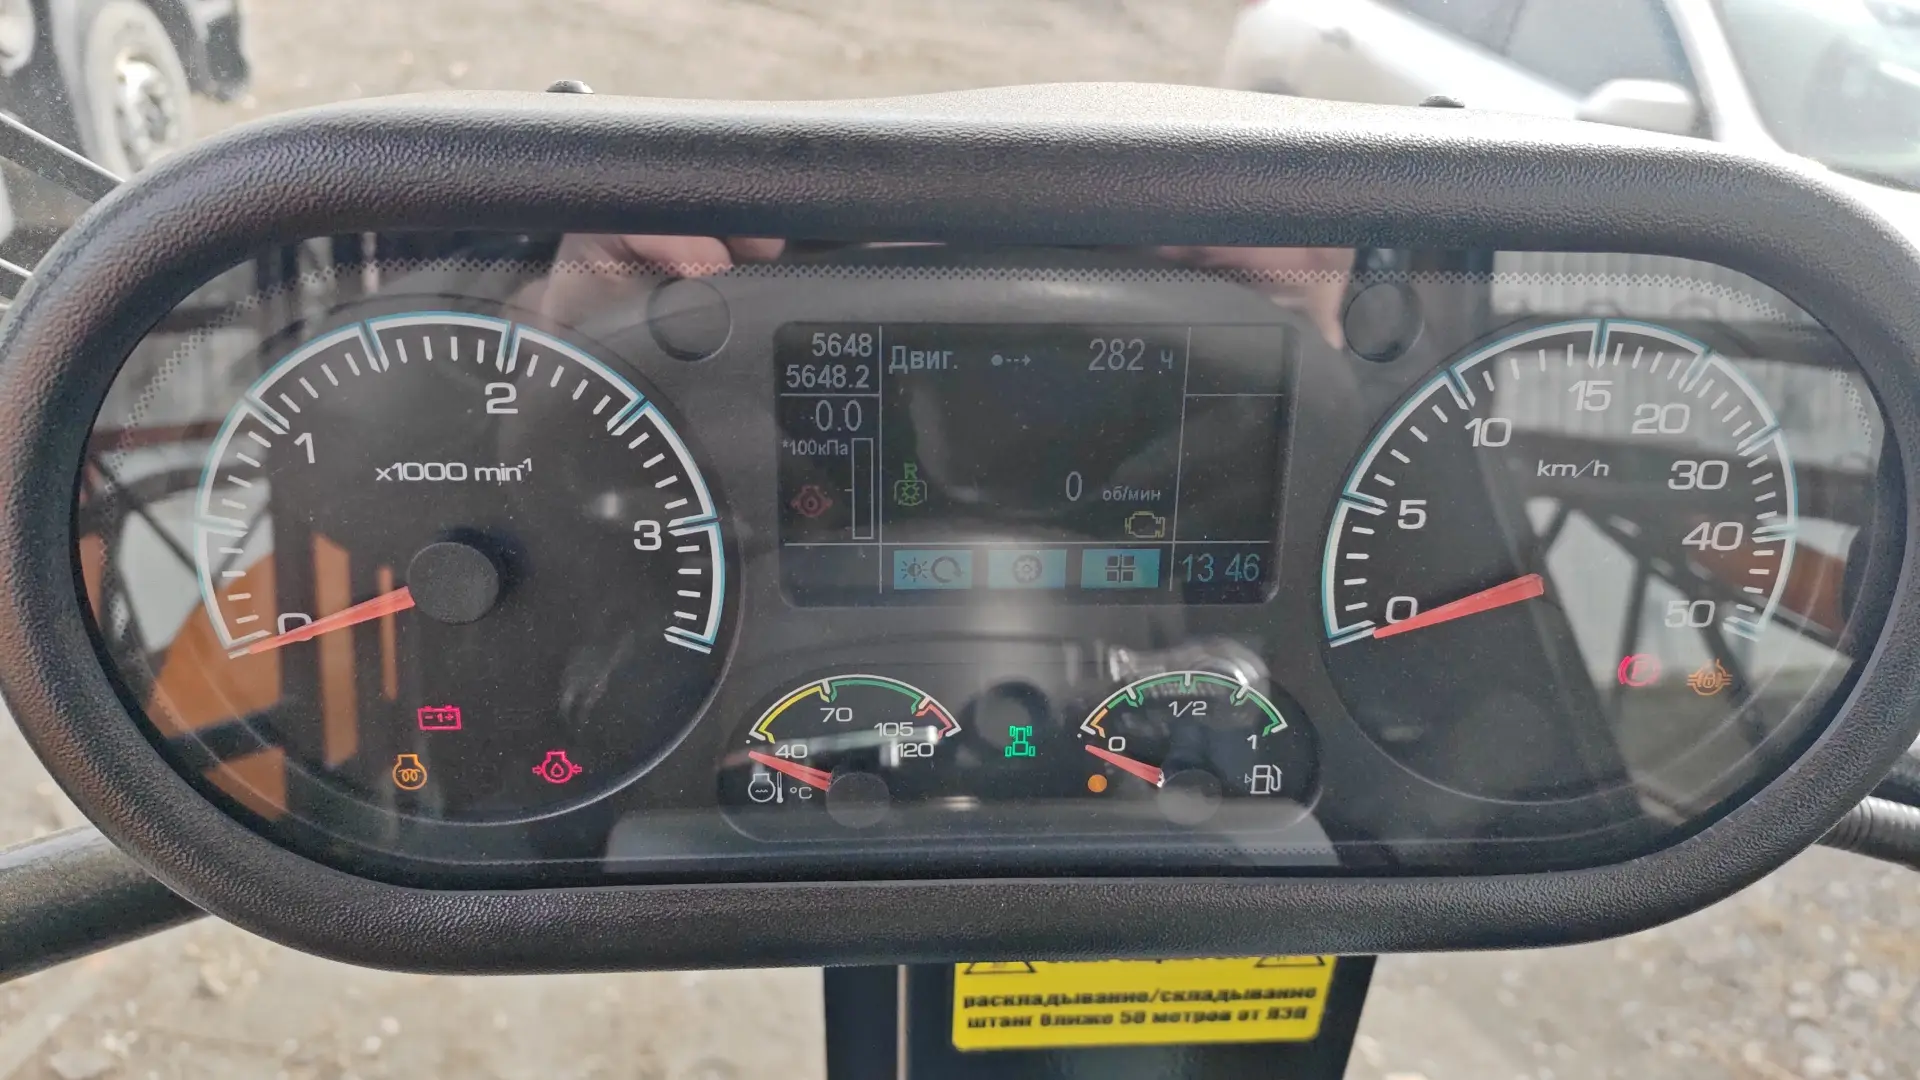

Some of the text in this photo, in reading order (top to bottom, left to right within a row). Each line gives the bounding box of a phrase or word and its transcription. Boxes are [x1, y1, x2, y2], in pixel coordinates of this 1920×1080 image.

[812, 333, 873, 357] 5648
[888, 345, 958, 374] Двиг.
[1088, 338, 1146, 371] 282
[786, 365, 870, 388] 5648.2
[484, 382, 518, 415] 2
[1567, 380, 1613, 411] 15
[815, 399, 862, 432] 0.0
[1631, 403, 1690, 435] 20
[1464, 417, 1512, 447] 10
[294, 432, 316, 464] 1
[1536, 459, 1609, 479] km/h
[1667, 460, 1729, 491] 30
[1065, 471, 1161, 502] 0 об/мин
[1397, 499, 1427, 530] 5
[634, 520, 662, 551] 3
[1682, 521, 1743, 551] 40
[1181, 552, 1261, 582] 13 46
[1385, 595, 1418, 625] 0
[1664, 600, 1715, 629] 50
[820, 707, 853, 723] 70
[1168, 700, 1207, 718] 1/2
[874, 722, 914, 738] 105
[1107, 736, 1126, 752] 0
[1247, 735, 1257, 750] 1
[775, 744, 808, 759] 40
[896, 742, 935, 758] 120
